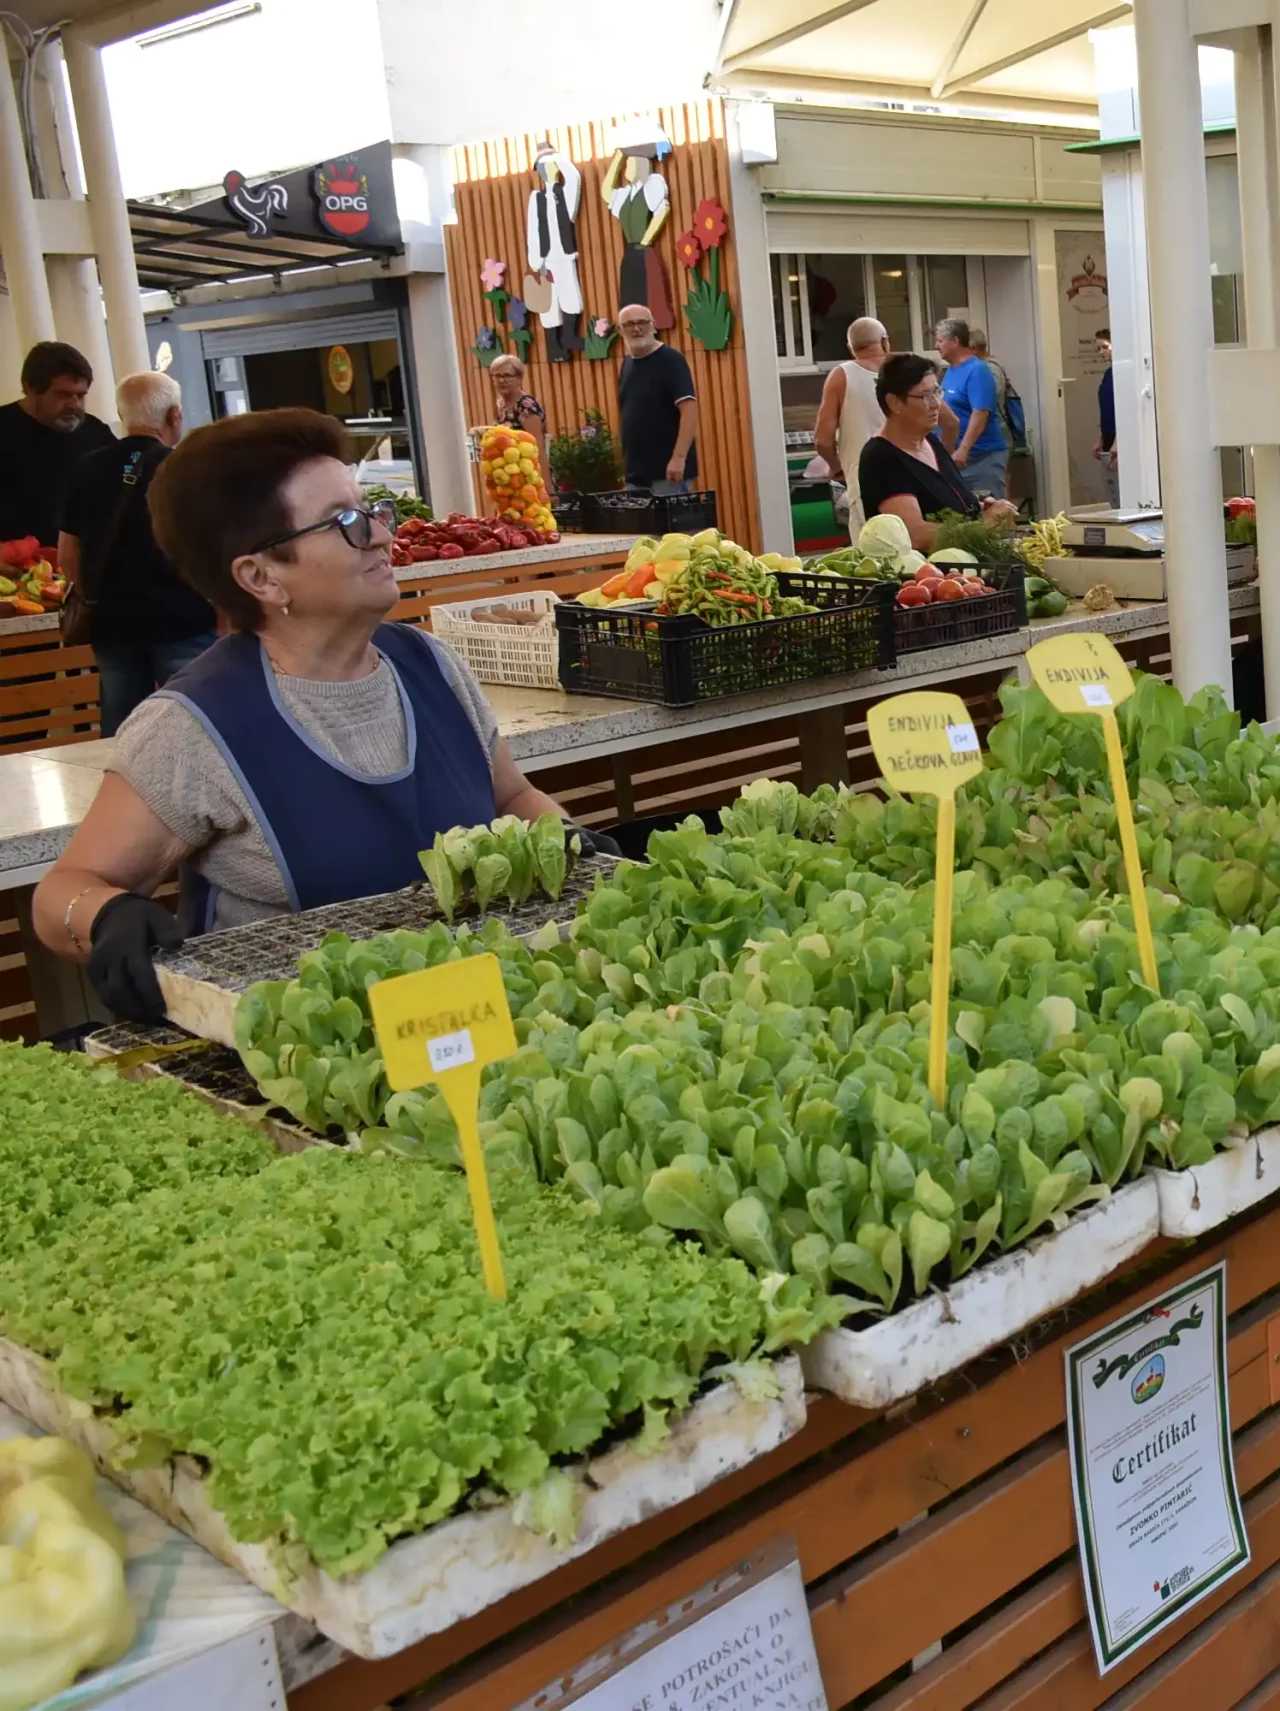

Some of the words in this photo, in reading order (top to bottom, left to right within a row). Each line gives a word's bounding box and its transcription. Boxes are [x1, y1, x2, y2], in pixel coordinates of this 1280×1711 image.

[325, 195, 368, 211] OPG
[1046, 666, 1110, 683] ENDIVIJA
[888, 713, 956, 732] ENDIVIJA
[1112, 1412, 1197, 1484] Certifikat
[1129, 1510, 1159, 1536] ZVONKO
[1160, 1482, 1193, 1514] PINTARIĆ
[660, 1624, 761, 1700] POTROŠAČI
[768, 1607, 793, 1630] DA
[691, 1648, 764, 1704] ZAKONA
[770, 1633, 783, 1650] O
